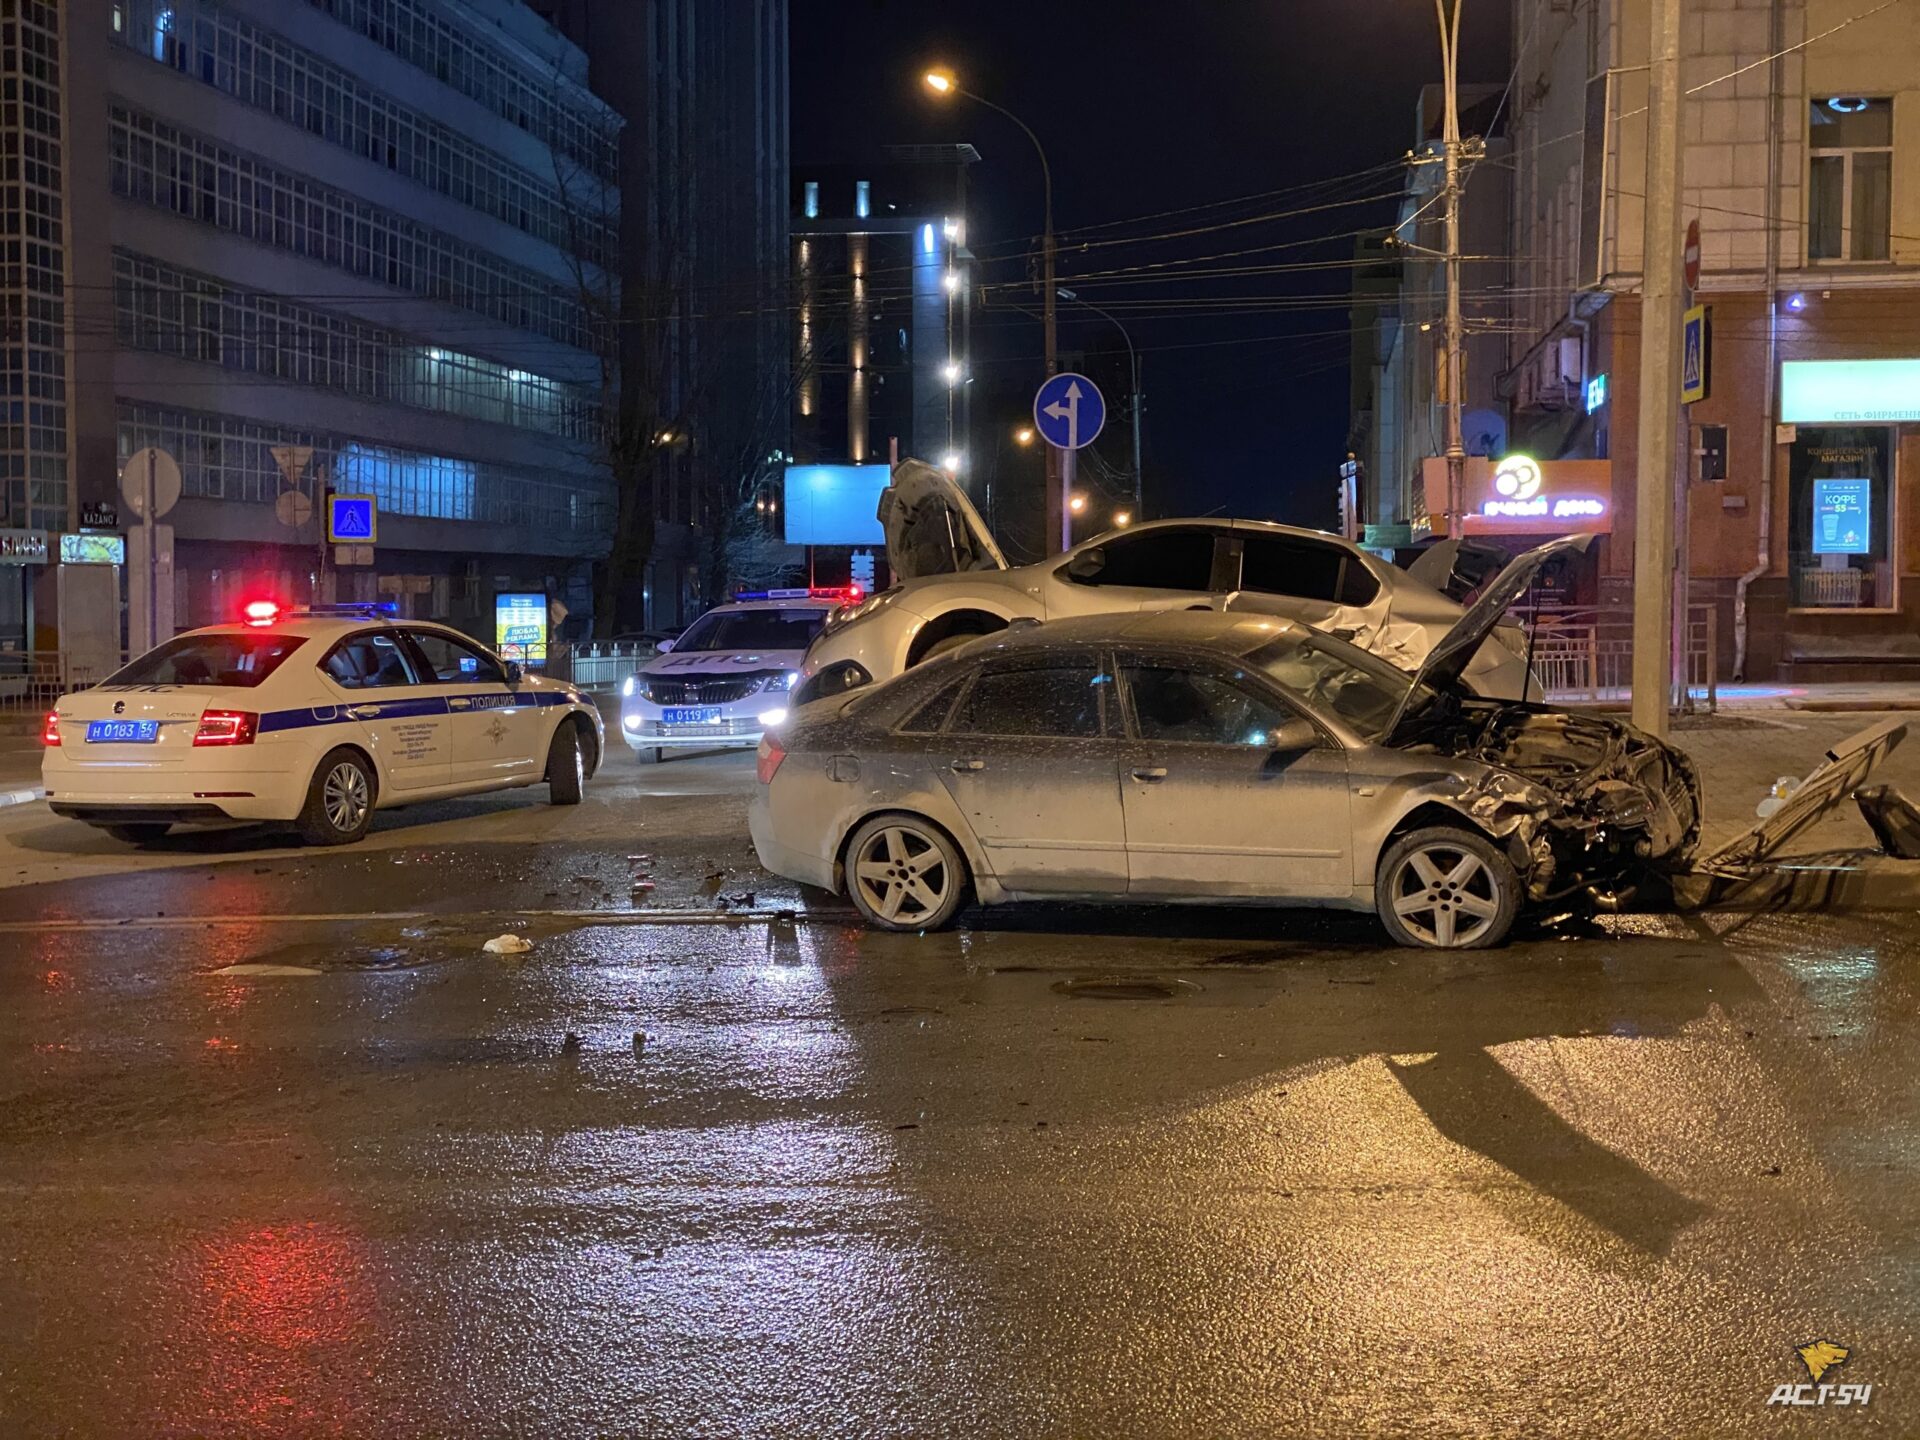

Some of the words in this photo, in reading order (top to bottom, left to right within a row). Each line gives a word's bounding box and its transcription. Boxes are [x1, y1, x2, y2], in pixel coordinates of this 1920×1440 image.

[1834, 411, 1861, 420] СЕТЬ
[1821, 454, 1864, 463] МАГАЗИН
[1825, 495, 1857, 504] КОФЕ
[1834, 504, 1847, 512] 55
[471, 695, 517, 708] ПОЛИЦИЯ
[104, 724, 135, 737] 0183
